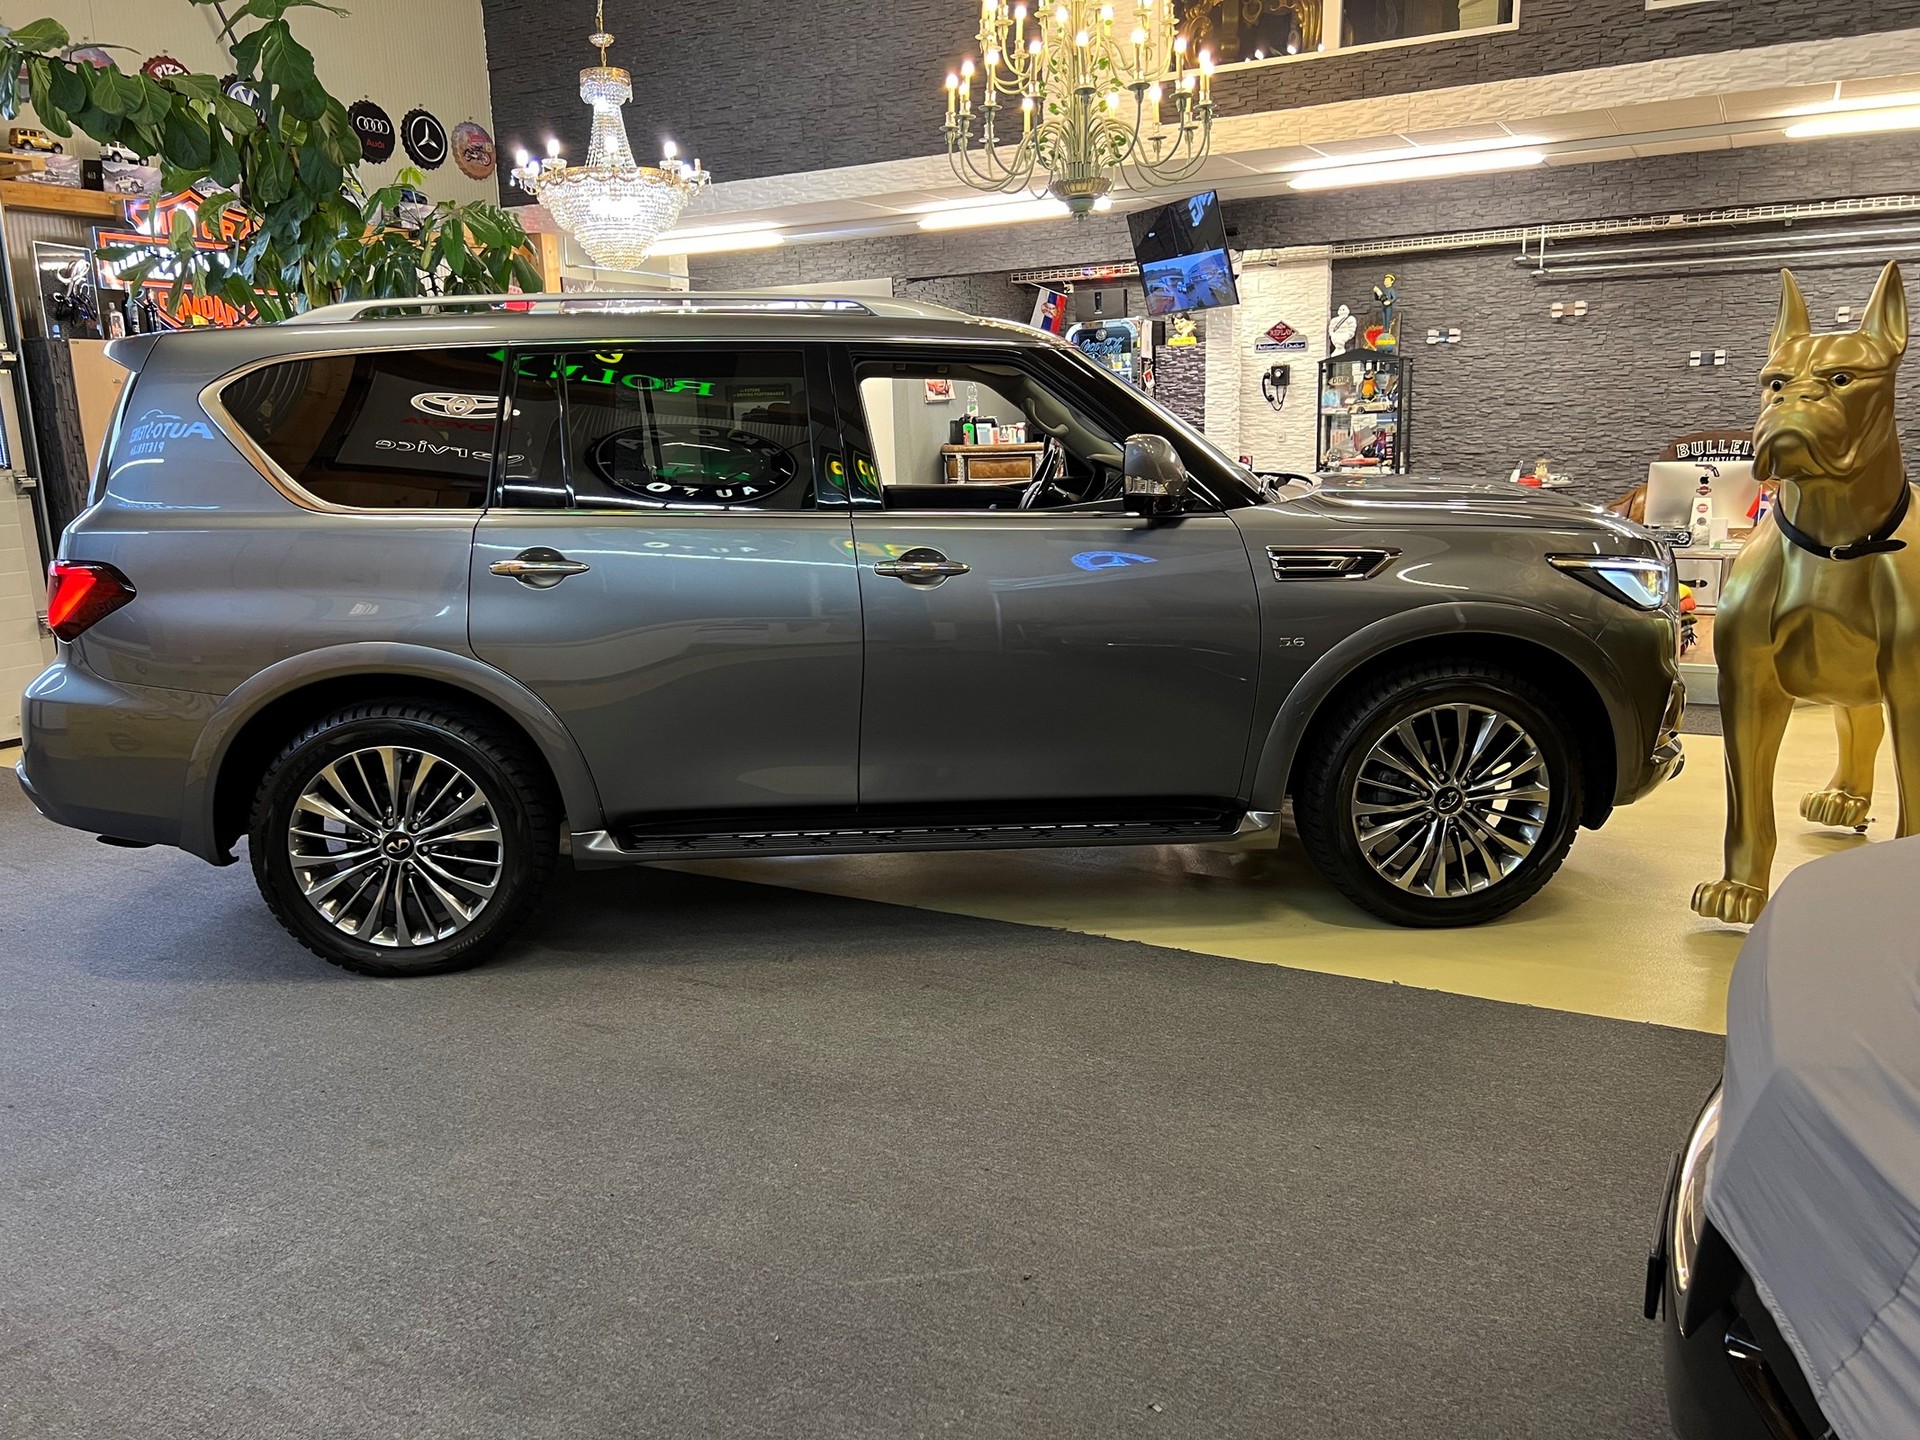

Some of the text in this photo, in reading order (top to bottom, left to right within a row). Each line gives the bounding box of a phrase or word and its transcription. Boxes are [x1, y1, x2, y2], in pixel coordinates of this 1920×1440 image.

[154, 63, 189, 78] PIZZ
[366, 138, 384, 149] Audi
[1676, 439, 1758, 458] BULLEI
